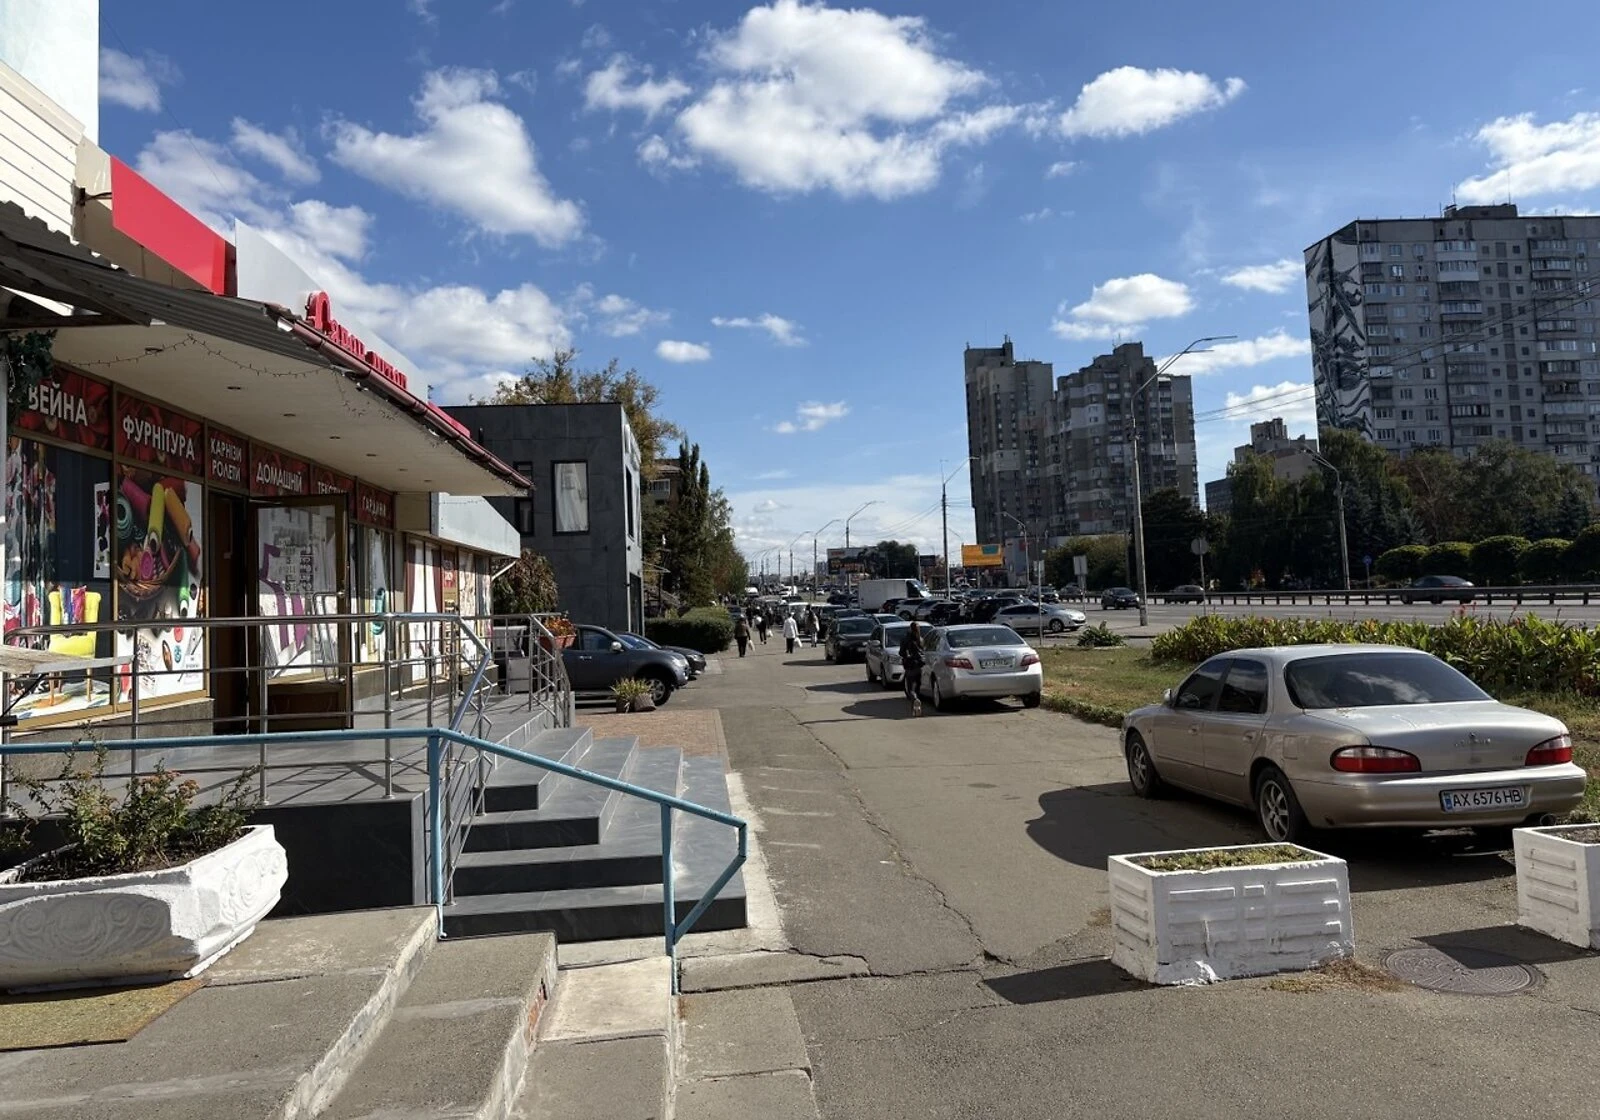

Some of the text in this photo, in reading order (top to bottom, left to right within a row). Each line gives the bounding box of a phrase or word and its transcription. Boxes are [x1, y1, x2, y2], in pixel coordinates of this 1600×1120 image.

[123, 414, 195, 461] ФУРНІТУРА
[210, 438, 242, 462] КАРНІЗИ
[212, 459, 241, 482] РОЛЕТИ
[256, 462, 303, 492] ДОМАШНІЙ
[1453, 789, 1522, 807] AX 6576 HB
